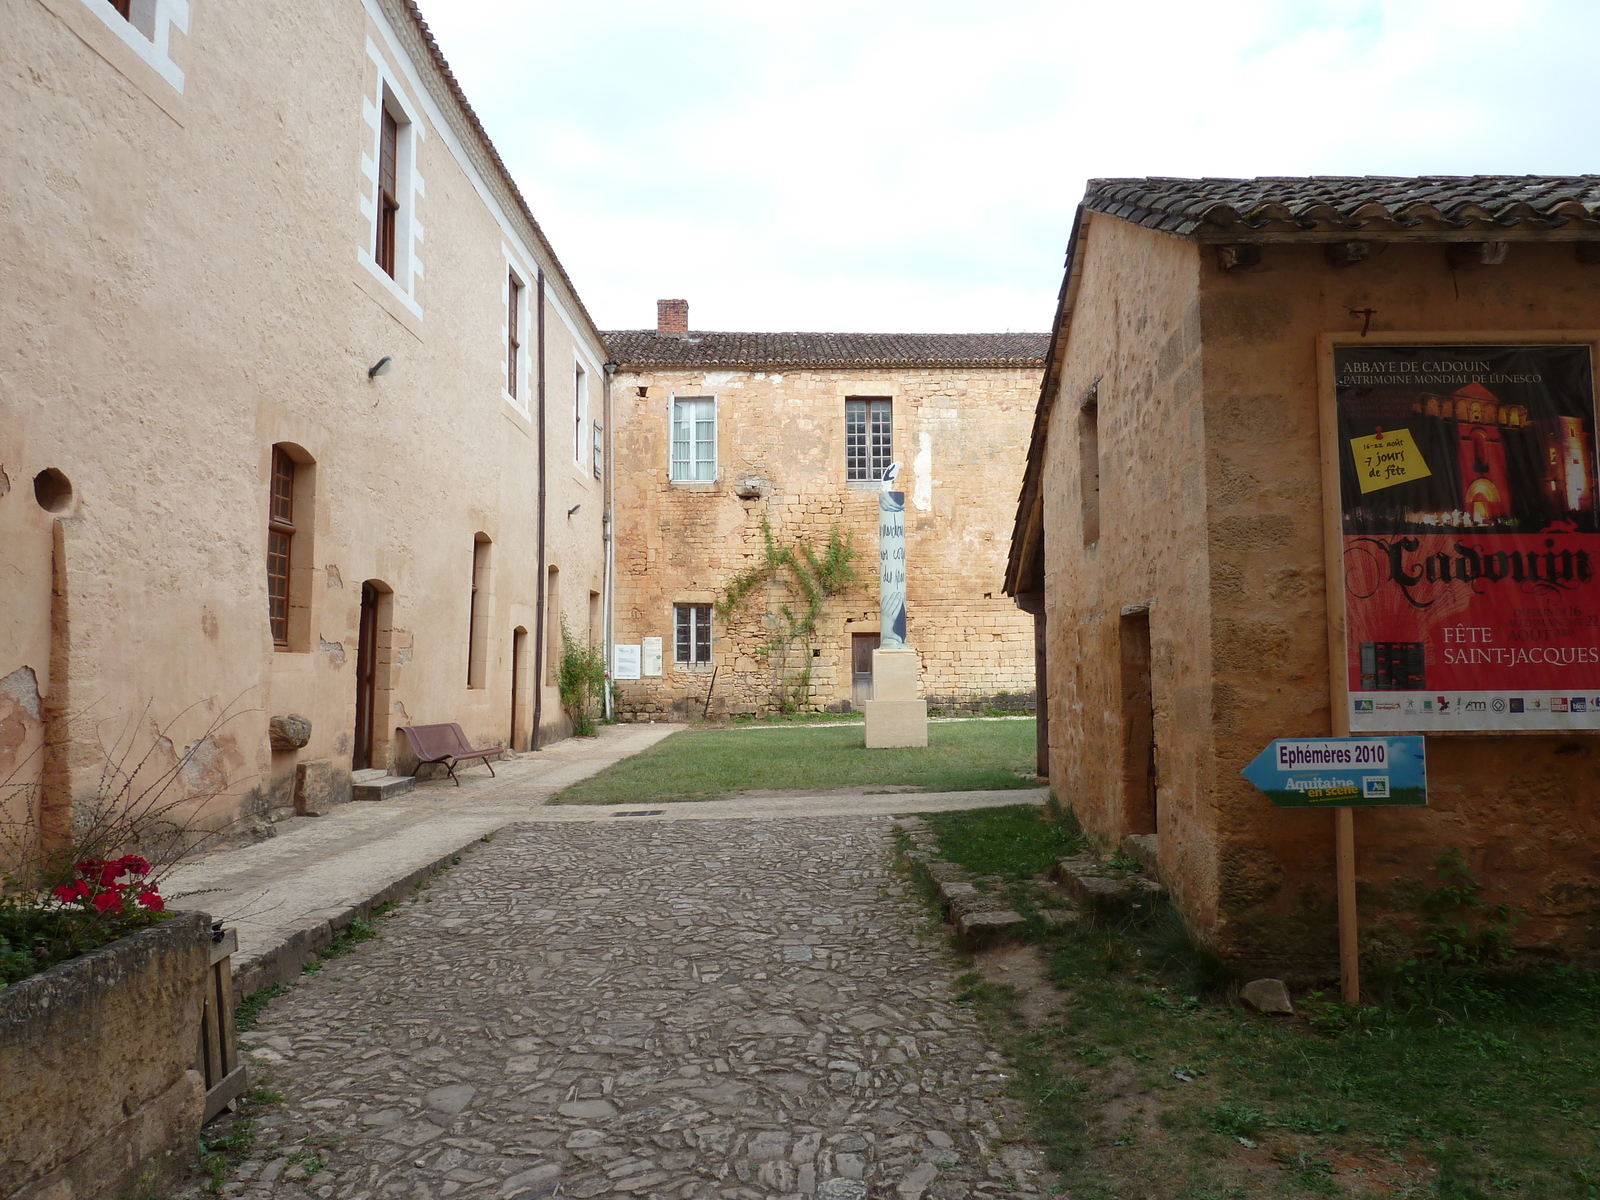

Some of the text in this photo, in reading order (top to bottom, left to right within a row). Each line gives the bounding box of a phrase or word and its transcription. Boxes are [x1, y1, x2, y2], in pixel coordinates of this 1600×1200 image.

[1343, 361, 1490, 373] ABBAYE DE CADOUIN
[1343, 373, 1542, 384] PATRIMOINE MONDIAL DE L'UNESCO
[1386, 438, 1404, 447] août
[1365, 450, 1405, 467] 7 jours
[1369, 464, 1406, 479] de fête
[1377, 536, 1594, 593] Cadouin
[1532, 608, 1566, 617] LUNDI
[1569, 605, 1582, 617] 16
[1586, 615, 1599, 627] 22
[1444, 623, 1492, 643] FÊTE
[1444, 647, 1599, 667] SAINT-JACQUES
[1280, 744, 1385, 768] Ephémères 2010
[1285, 776, 1355, 793] Aquitaine
[1307, 783, 1358, 798] en scène
